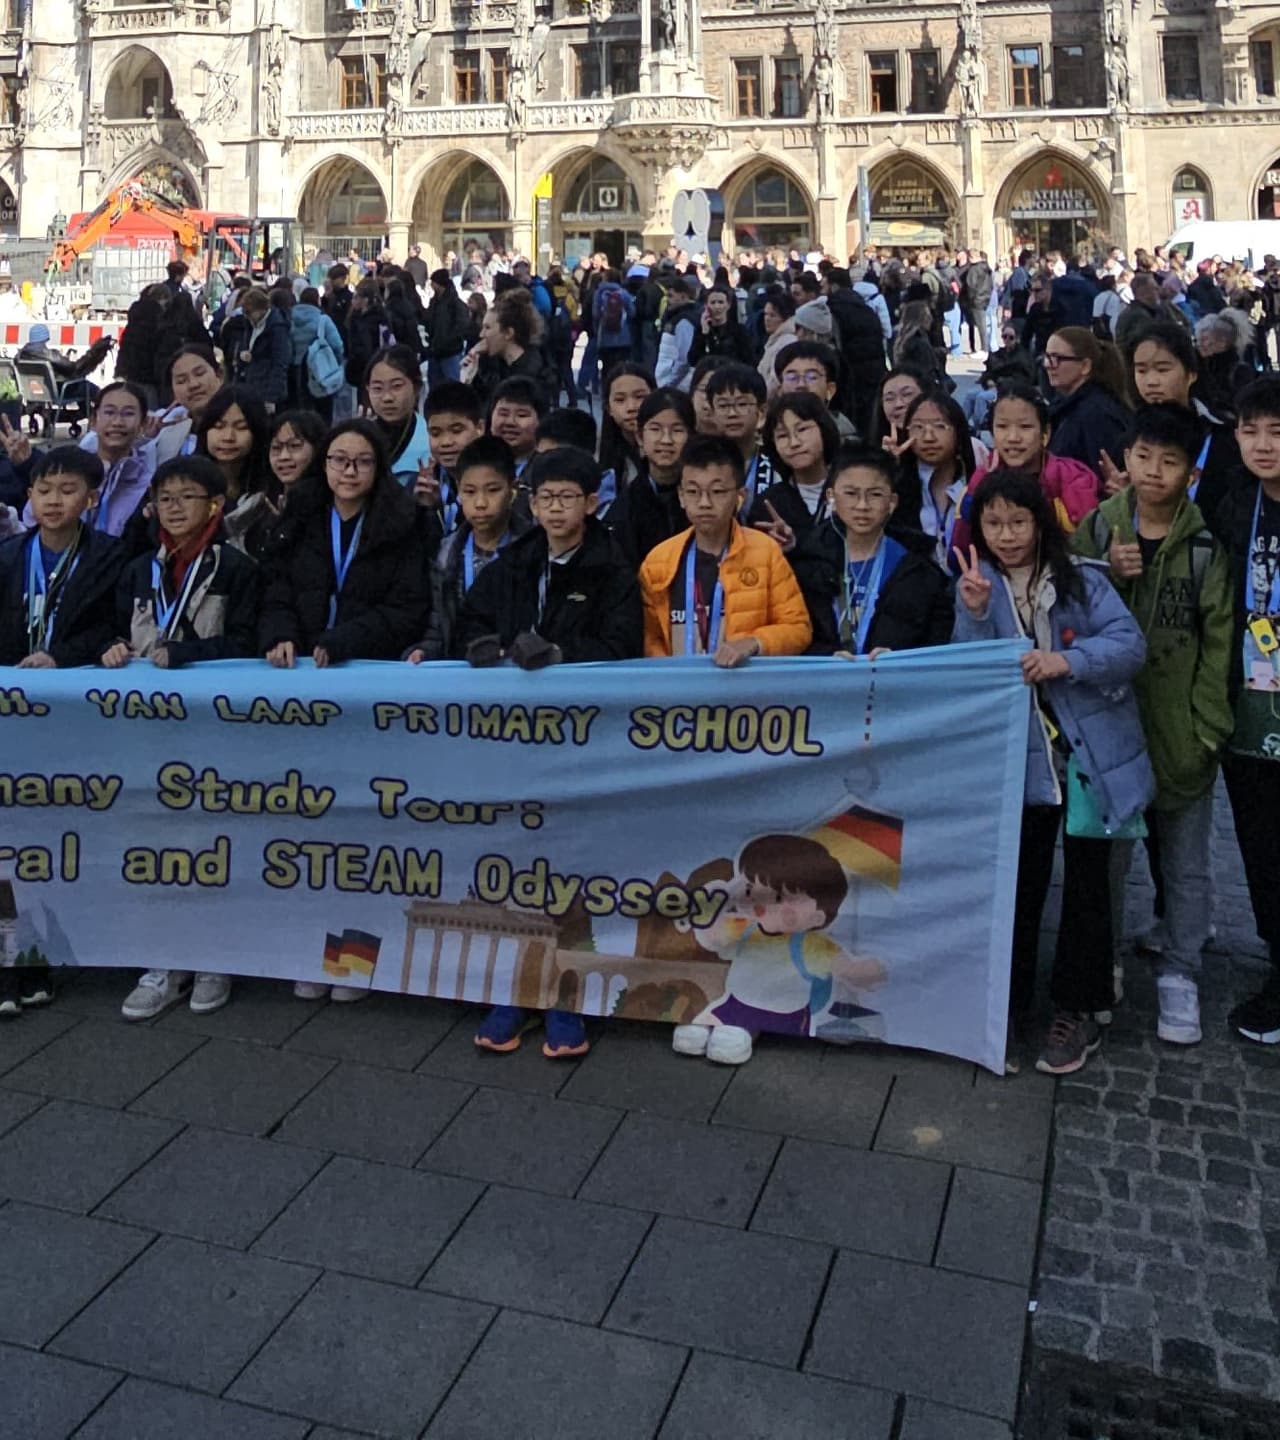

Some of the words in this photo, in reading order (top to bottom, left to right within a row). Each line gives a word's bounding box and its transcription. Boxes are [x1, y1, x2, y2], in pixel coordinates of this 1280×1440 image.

[1014, 199, 1094, 211] APOTHEKE
[1022, 189, 1086, 201] RATHAUS
[86, 689, 188, 721] YAN
[213, 695, 342, 727] LAAP
[372, 701, 601, 746] PRIMARY
[628, 704, 824, 757] SCHOOL
[157, 760, 336, 819] Study
[370, 776, 545, 830] Tour:
[122, 835, 232, 888] and
[261, 838, 444, 898] STEAM
[474, 853, 729, 930] Odyssey
